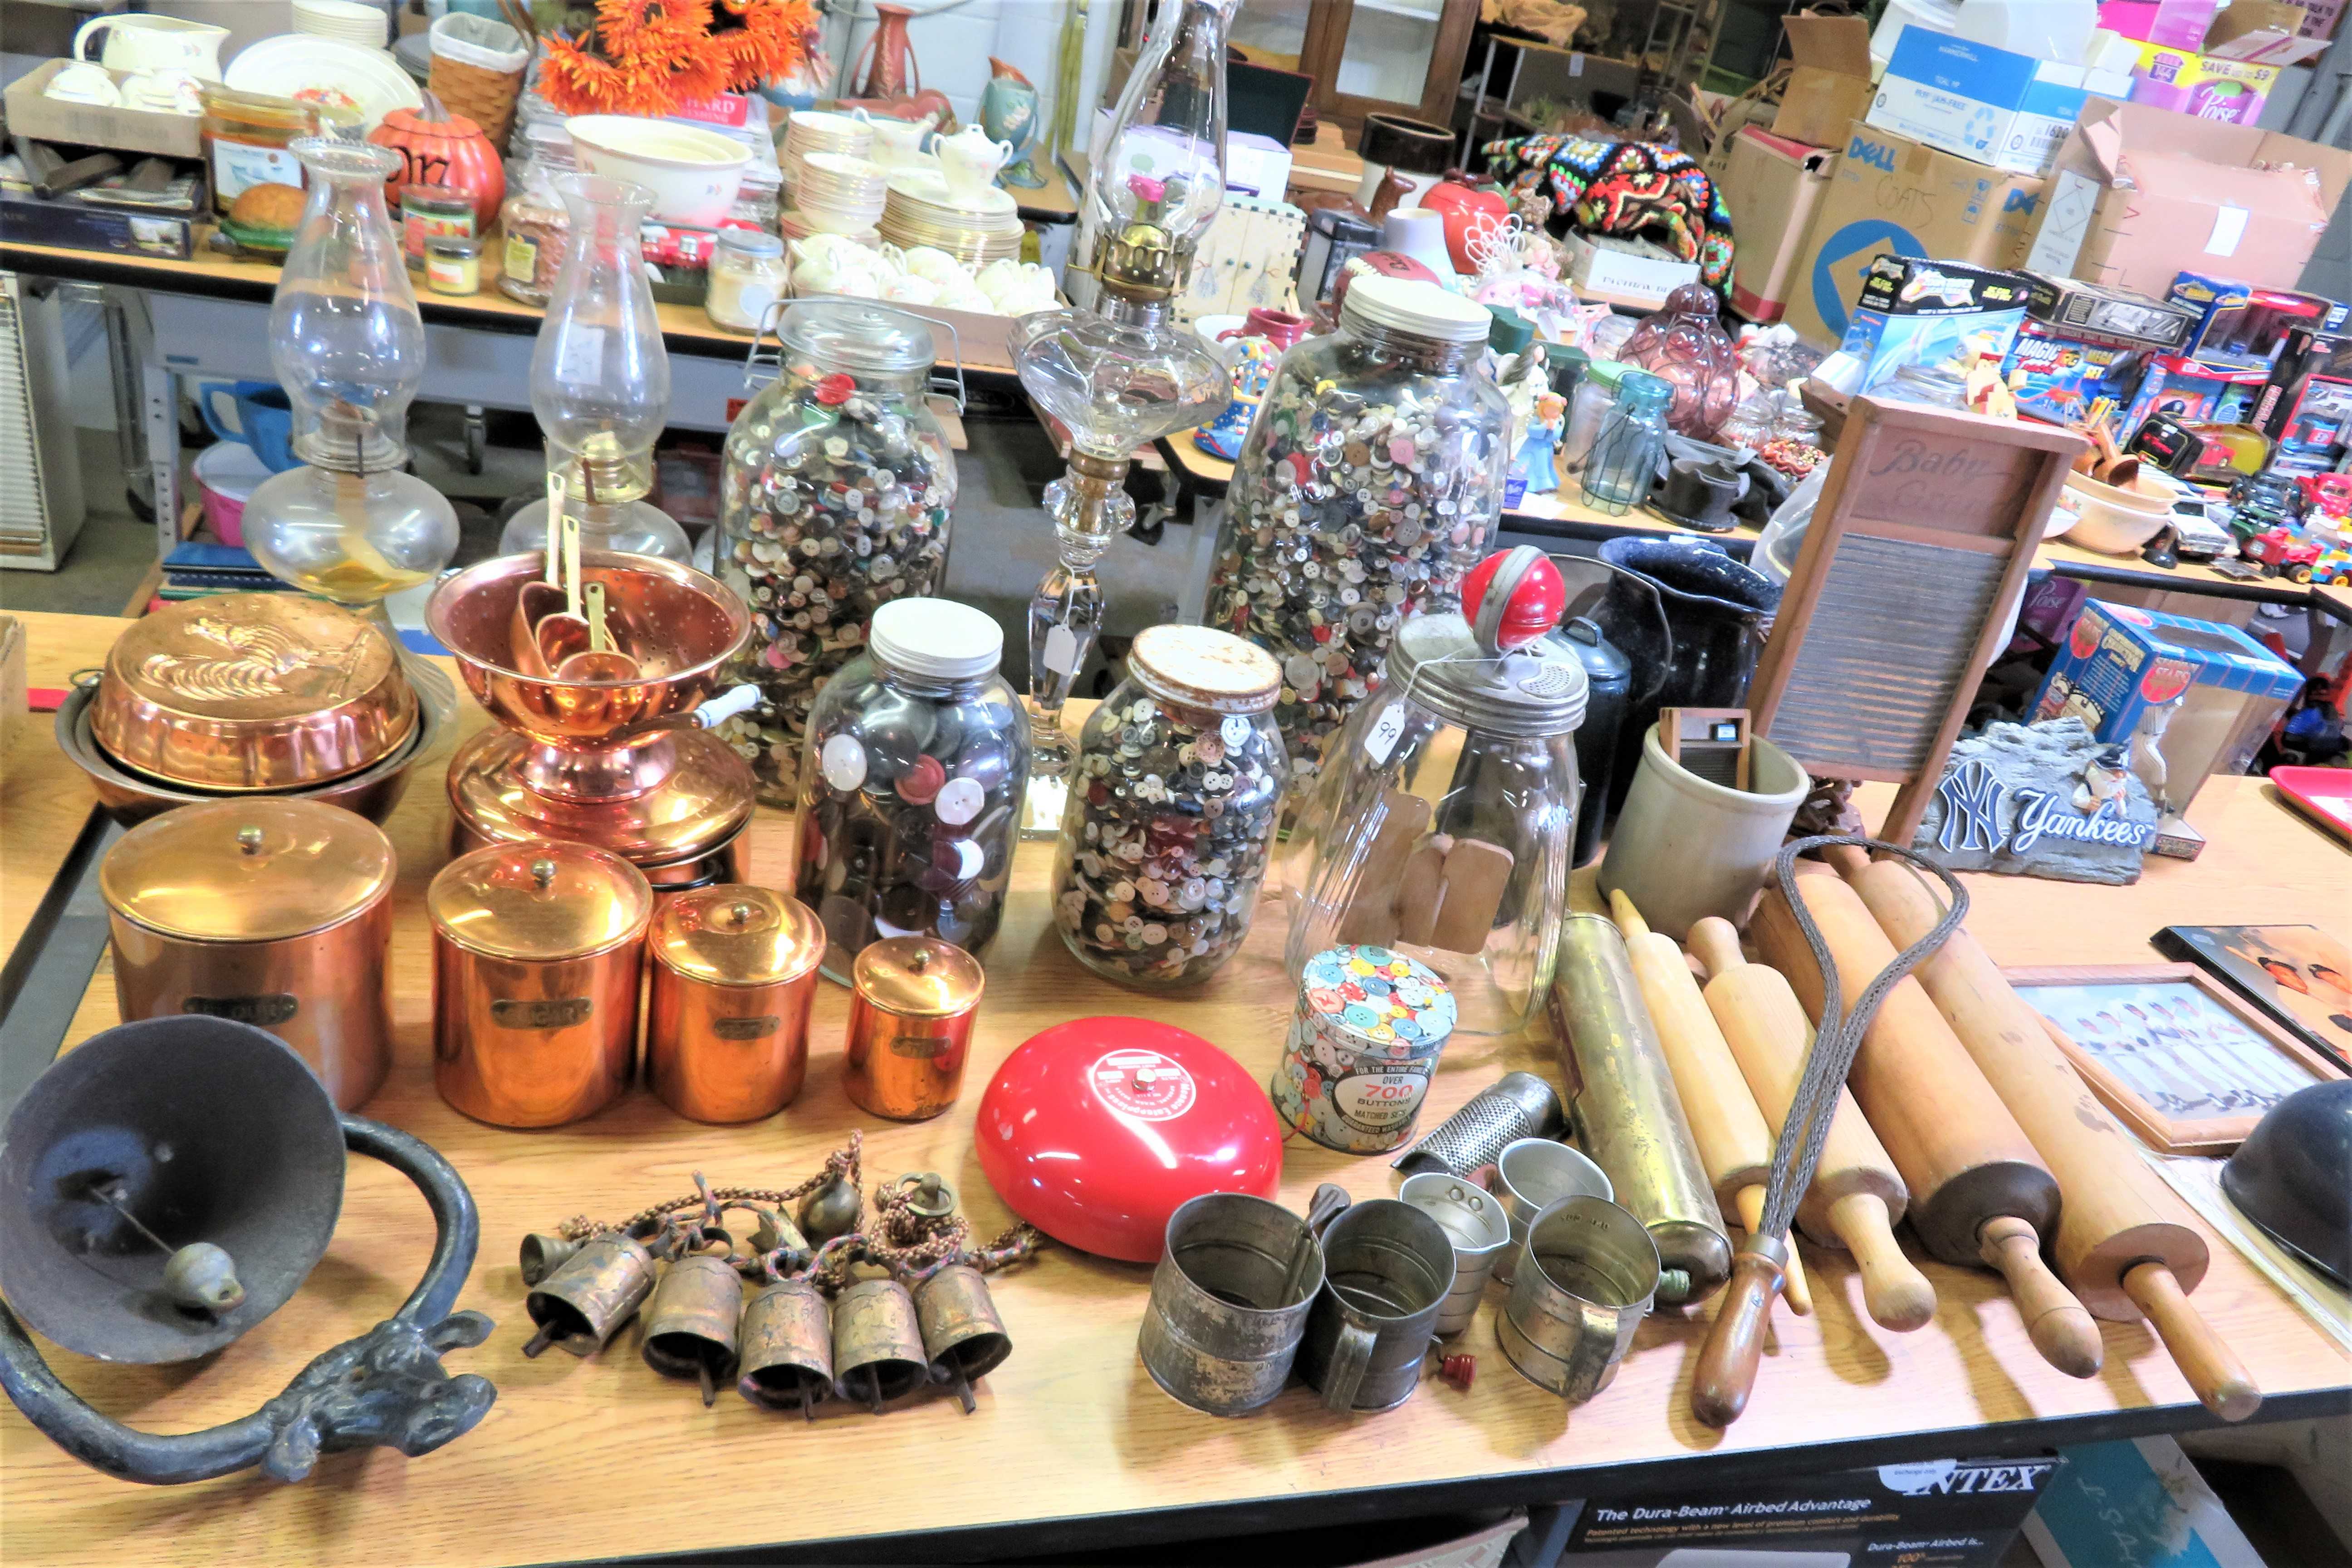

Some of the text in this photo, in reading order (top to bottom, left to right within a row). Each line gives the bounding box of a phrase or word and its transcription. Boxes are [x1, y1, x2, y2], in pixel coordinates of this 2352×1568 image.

[2201, 61, 2229, 75] SAVE
[2198, 86, 2240, 122] Poise
[1847, 136, 1896, 173] DELL
[2014, 338, 2063, 362] MAGIC
[1379, 722, 1397, 745] 99
[2014, 788, 2146, 853] Yankees
[1355, 1066, 1369, 1075] FOR
[1382, 1076, 1404, 1085] OVER
[1365, 1084, 1414, 1099] 700
[1357, 1098, 1411, 1107] BUTTONS
[1354, 1109, 1388, 1120] MATCHED
[1597, 1498, 1872, 1522] The Dura-Beam Airbed Advantage
